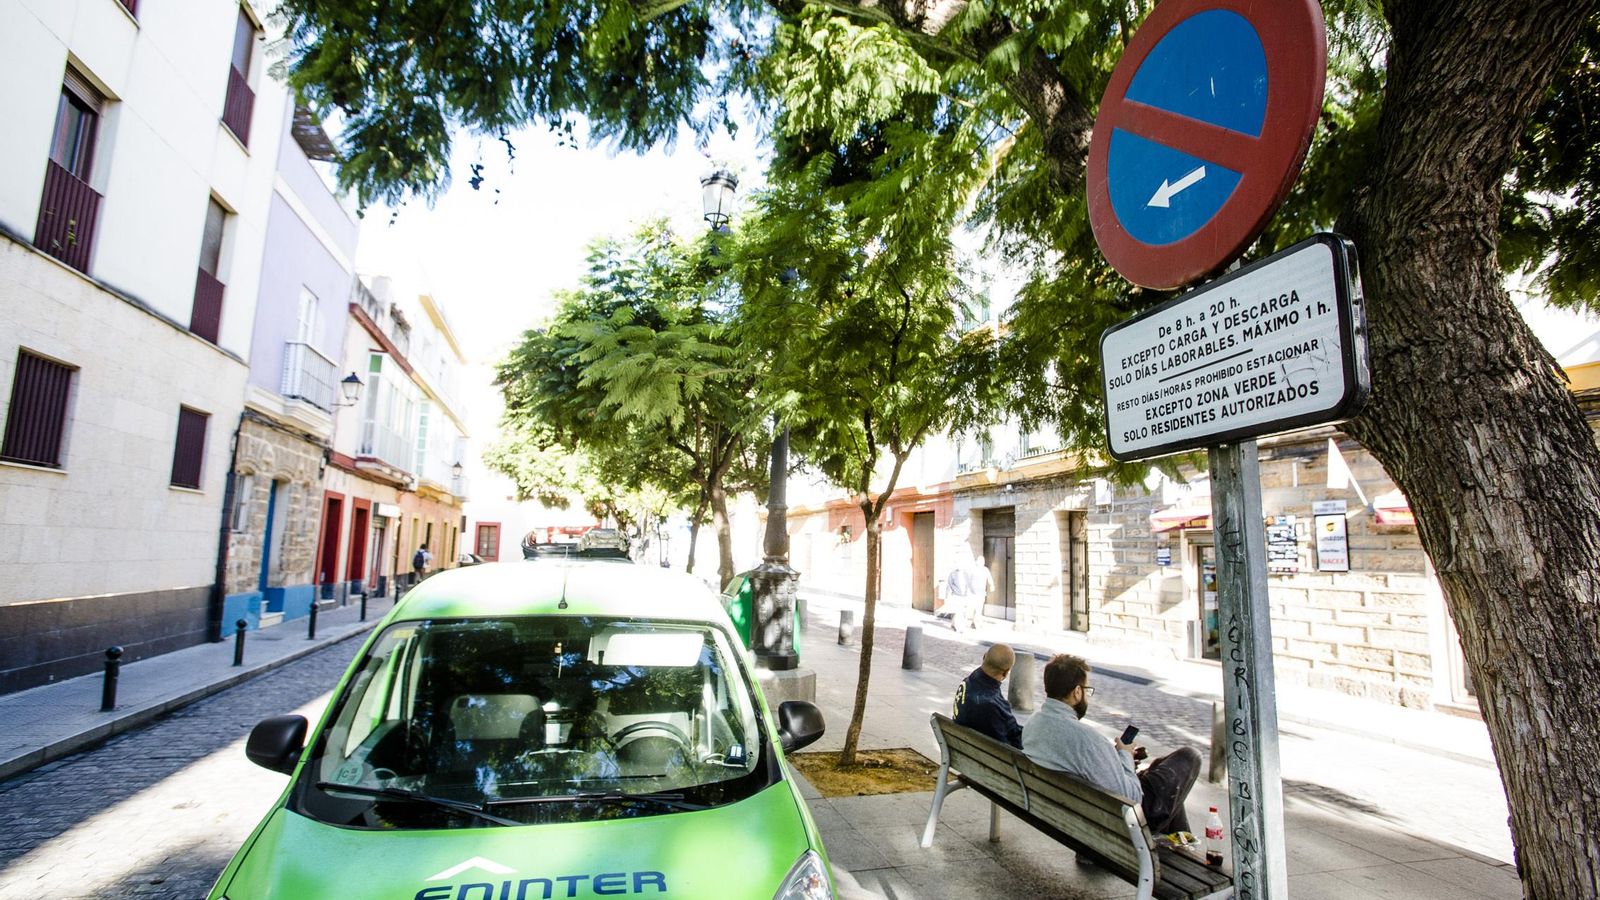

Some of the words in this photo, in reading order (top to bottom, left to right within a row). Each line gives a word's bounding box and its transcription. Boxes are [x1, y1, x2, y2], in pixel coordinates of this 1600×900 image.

[1109, 373, 1132, 390] SOLO
[1134, 363, 1158, 381] DÍAS
[1161, 334, 1239, 372] LABORABLES.
[1242, 310, 1300, 343] MÁXIMO
[1305, 304, 1312, 319] 1
[1316, 301, 1331, 316] h.
[1121, 344, 1165, 369] EXCEPTO
[1168, 327, 1207, 351] CARGA
[1211, 321, 1219, 334] Y
[1224, 289, 1300, 330] DESCARGA
[1158, 327, 1171, 338] De
[1175, 320, 1183, 331] 8
[1185, 315, 1196, 328] h.
[1199, 312, 1206, 321] a
[1209, 301, 1225, 317] 20
[1229, 296, 1241, 309] h.
[1116, 397, 1140, 412] RESTO
[1194, 363, 1243, 388] PROHIBIDO
[1246, 338, 1319, 371] ESTACIONAR
[1145, 397, 1193, 420] EXCEPTO
[1196, 386, 1230, 406] ZONA
[1233, 371, 1277, 395] VERDE
[1123, 427, 1148, 442] SOLO
[1150, 409, 1216, 436] RESIDENTES
[1221, 380, 1320, 418] AUTORIZADOS
